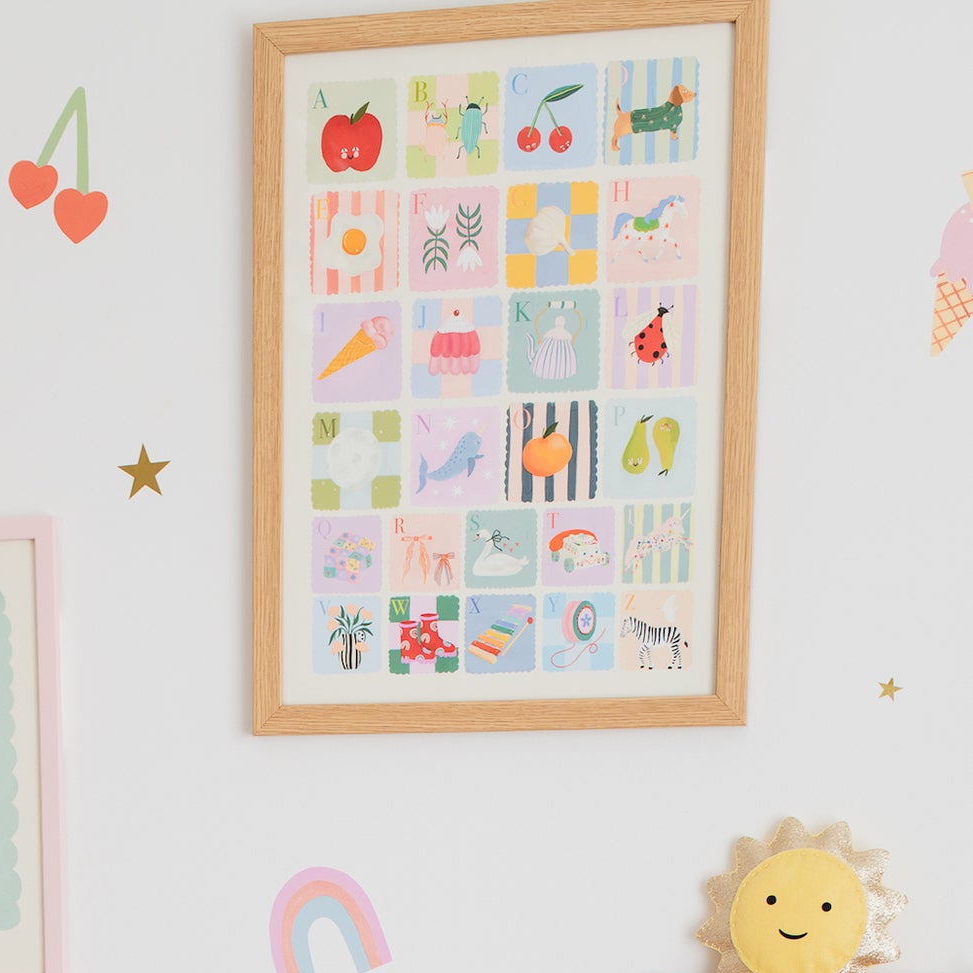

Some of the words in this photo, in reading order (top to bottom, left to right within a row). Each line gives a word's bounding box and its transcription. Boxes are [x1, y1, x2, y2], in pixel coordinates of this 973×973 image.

[414, 81, 428, 103] B
[511, 72, 528, 95] C
[313, 88, 328, 109] A
[613, 181, 630, 202] H
[316, 198, 330, 220] E
[413, 192, 427, 215] F
[418, 304, 426, 328] J
[514, 300, 532, 323] K
[614, 296, 628, 318] L
[416, 413, 432, 435] N
[512, 407, 531, 430] O
[613, 405, 626, 426] P
[319, 417, 337, 439] M
[317, 518, 332, 540] Q
[394, 517, 406, 534] R
[469, 514, 480, 531] S
[546, 512, 560, 529] T
[390, 599, 410, 617] W
[469, 597, 481, 615] X
[624, 594, 635, 611] Z
